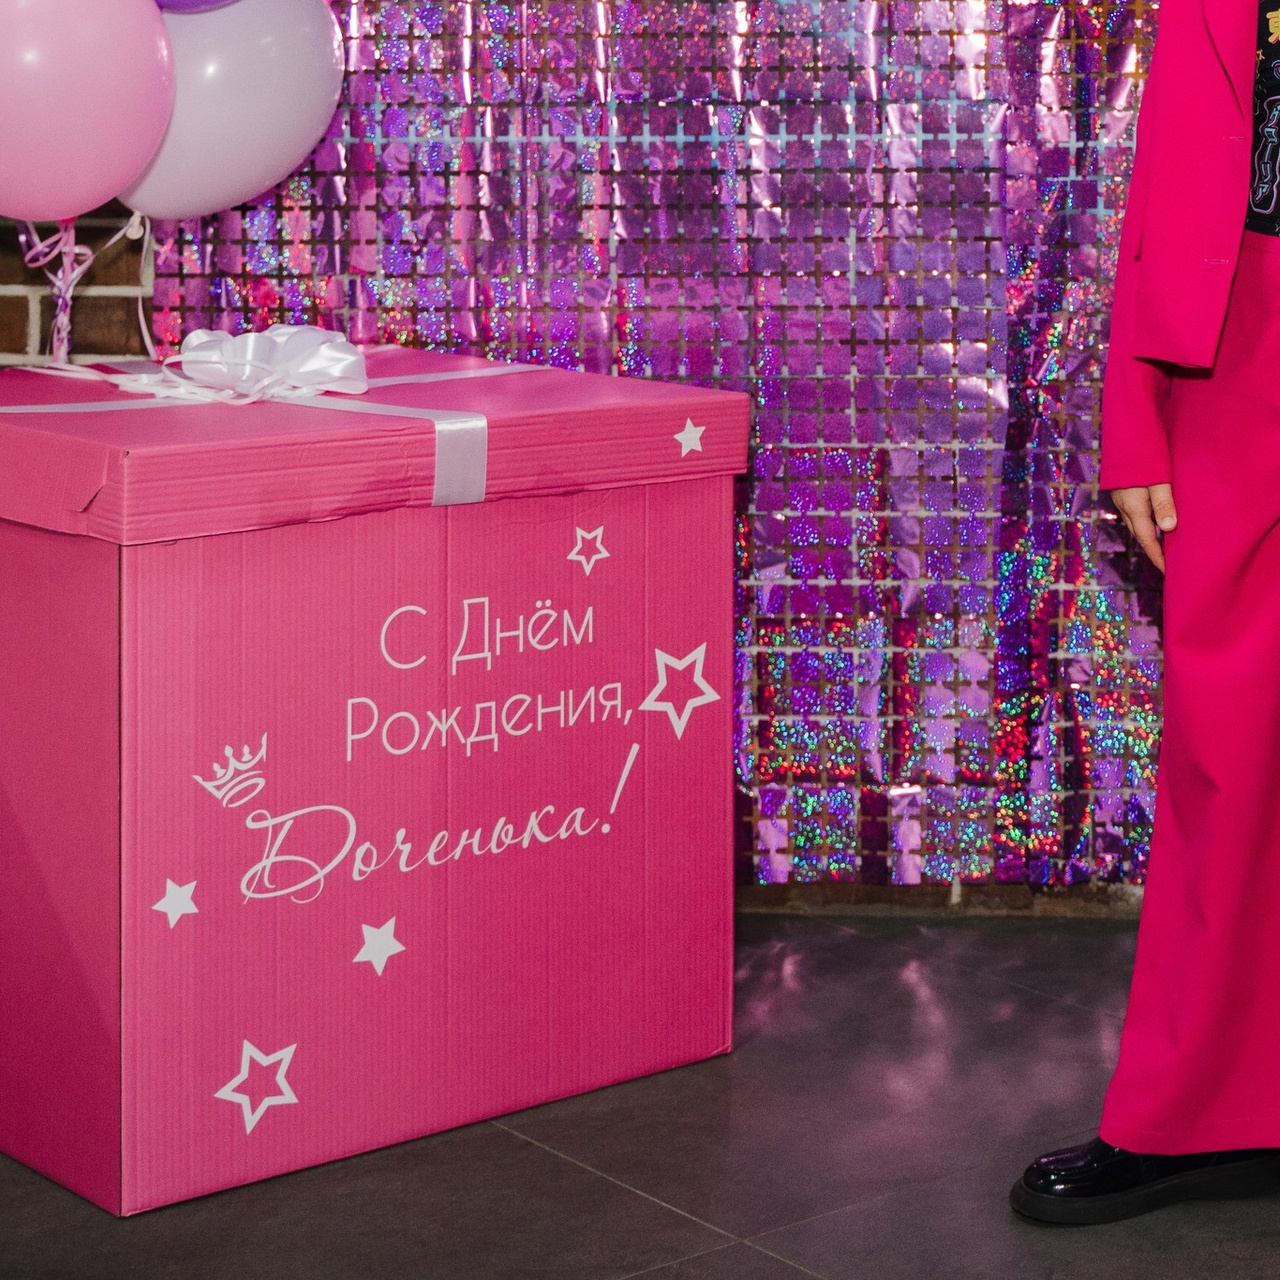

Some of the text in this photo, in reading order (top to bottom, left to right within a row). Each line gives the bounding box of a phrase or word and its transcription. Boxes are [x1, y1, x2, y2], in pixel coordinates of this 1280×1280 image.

[380, 596, 594, 676] С Днём
[346, 682, 634, 762] Рождения,
[240, 742, 640, 904] Доченька!
